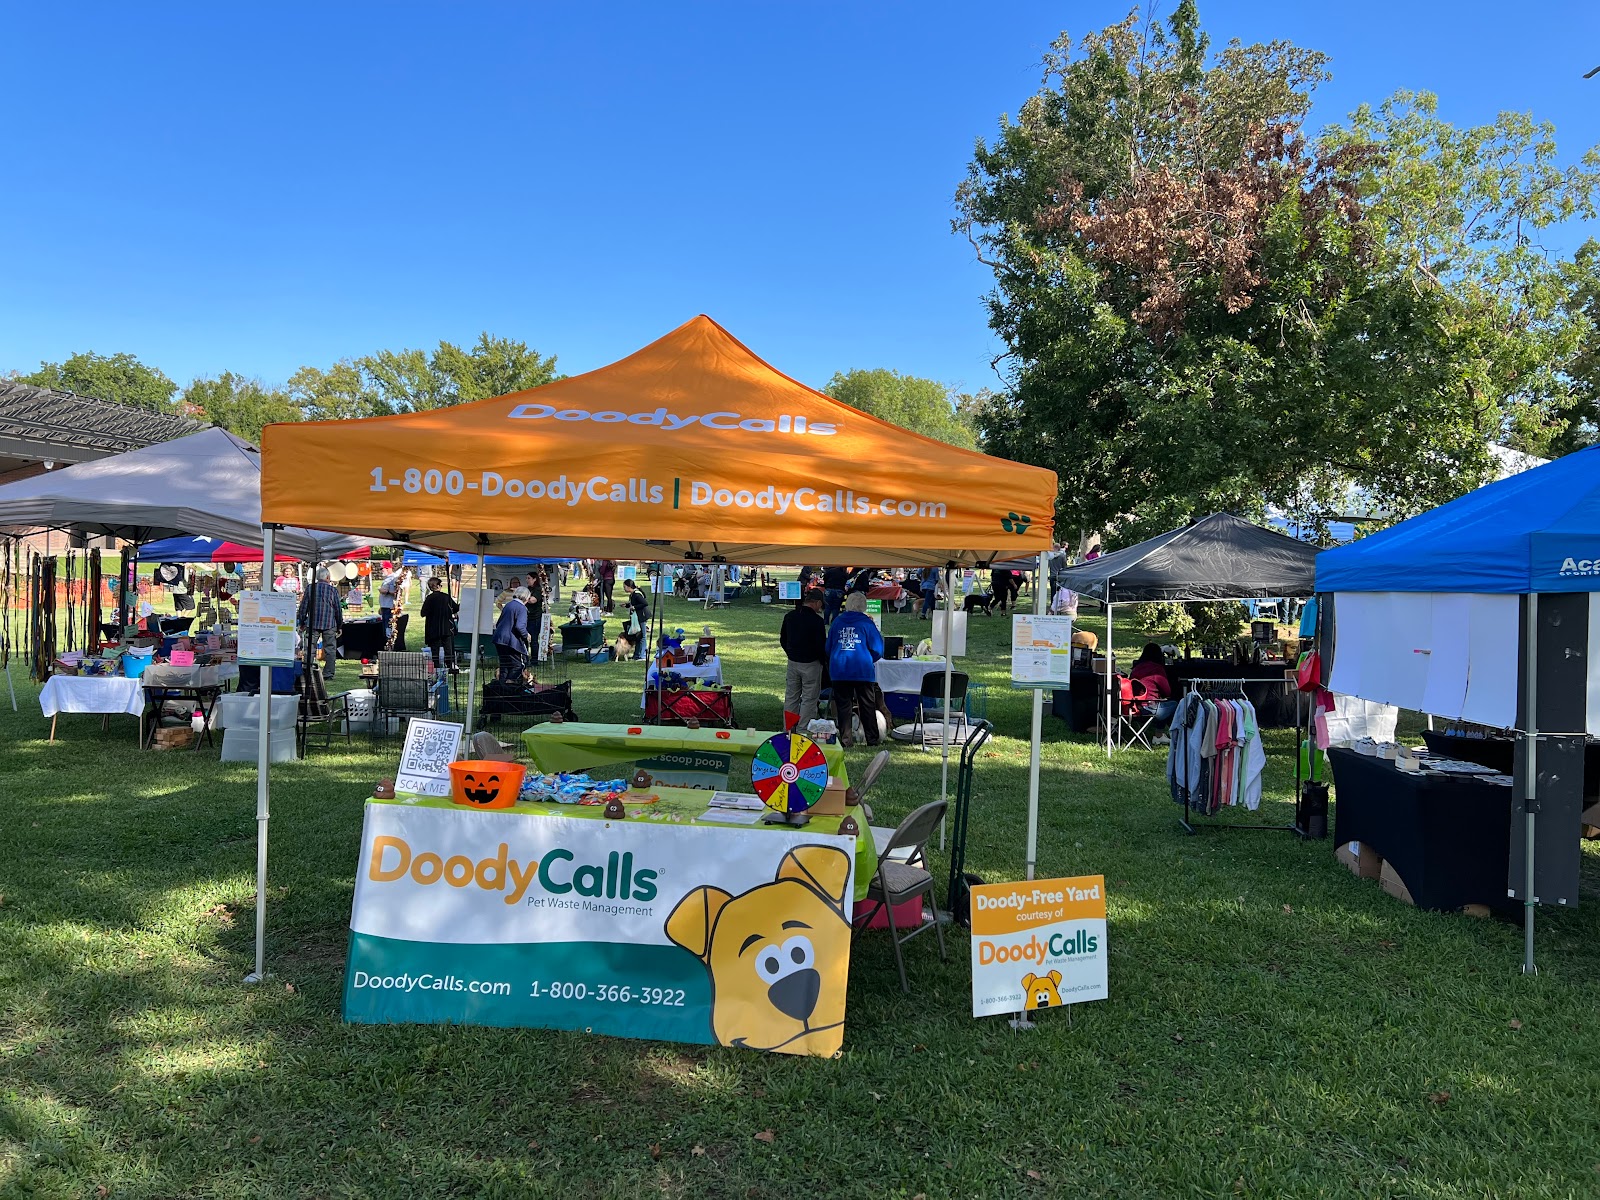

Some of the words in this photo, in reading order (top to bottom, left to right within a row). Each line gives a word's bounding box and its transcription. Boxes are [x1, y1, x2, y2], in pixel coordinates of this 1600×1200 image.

[507, 404, 837, 435] DoodyCalls
[369, 466, 664, 506] 1-800-DoodyCalls
[690, 481, 947, 518] DoodyCalls.com
[660, 754, 692, 766] scoop
[694, 757, 725, 769] poop.
[400, 779, 428, 792] SCAN
[430, 784, 446, 794] ME
[368, 835, 658, 905] DoodyCalls
[527, 896, 545, 908] Pet
[548, 898, 580, 910] Waste
[582, 900, 653, 916] Management
[976, 889, 1064, 910] Doody-Free
[1066, 885, 1100, 902] Yard
[1016, 910, 1053, 922] courtesy
[1054, 908, 1064, 918] of
[978, 929, 1098, 966] DoodyCalls
[1067, 954, 1097, 964] Management
[353, 971, 511, 996] DoodyCalls.com
[529, 980, 686, 1007] 1-800-366-3922
[980, 994, 1022, 1005] 1-800-366-3922
[1062, 984, 1102, 994] DoodyCalls.com
